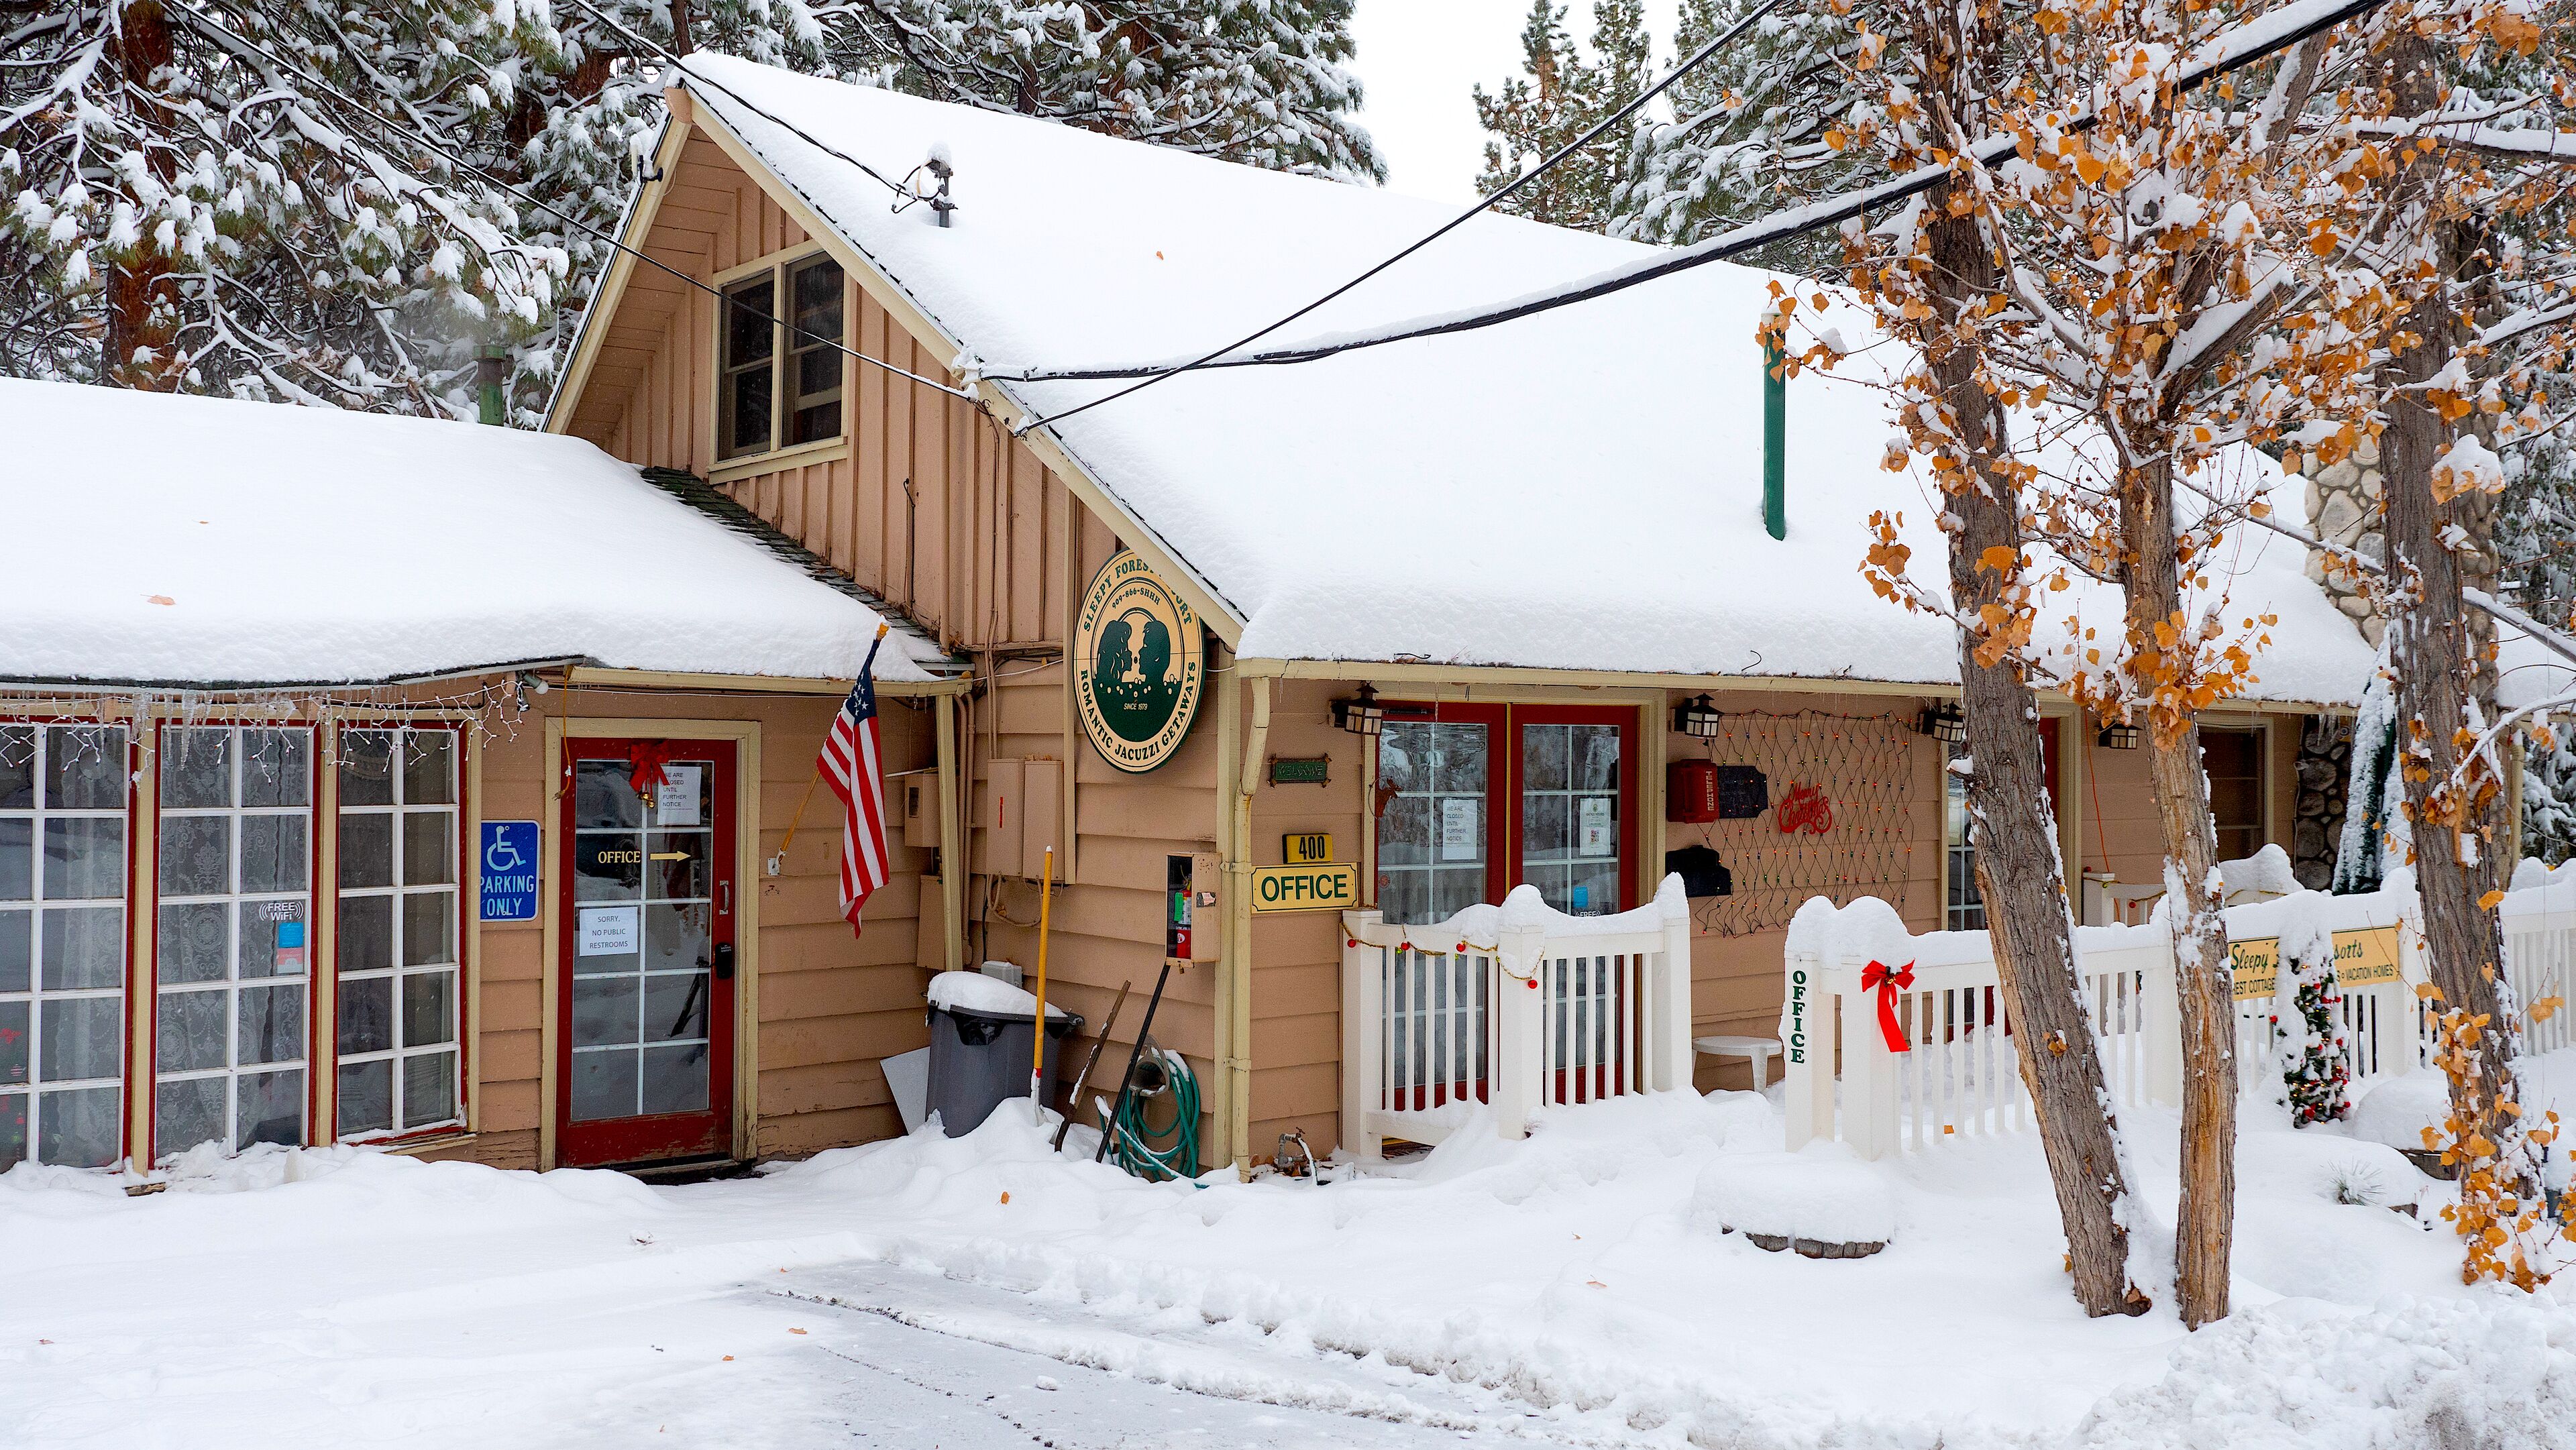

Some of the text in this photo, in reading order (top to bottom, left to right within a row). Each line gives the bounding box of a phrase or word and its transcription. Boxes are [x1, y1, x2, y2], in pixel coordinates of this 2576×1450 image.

[1084, 575, 1112, 632] SLEEPY
[1116, 559, 1153, 578] FORES
[1112, 588, 1161, 609] 909-866-SHHH
[1081, 661, 1196, 761] ROMANTIC JACUZZI GETAWAYS
[1705, 771, 1715, 811] TELEPHONE
[598, 850, 641, 864] OFFICE
[1299, 836, 1325, 860] 400
[480, 875, 535, 893] PARKING
[1261, 874, 1348, 901] OFFICE
[268, 902, 295, 911] FREE
[270, 911, 292, 921] WiFi
[486, 897, 523, 916] ONLY
[589, 940, 629, 949] RESTROOMS
[2231, 944, 2268, 974] Sleepy
[2334, 939, 2363, 960] sorts
[2249, 977, 2275, 993] COTTAGE
[2345, 966, 2372, 981] VACATION
[2373, 963, 2394, 978] HOMES
[1790, 970, 1807, 1064] OFFICE
